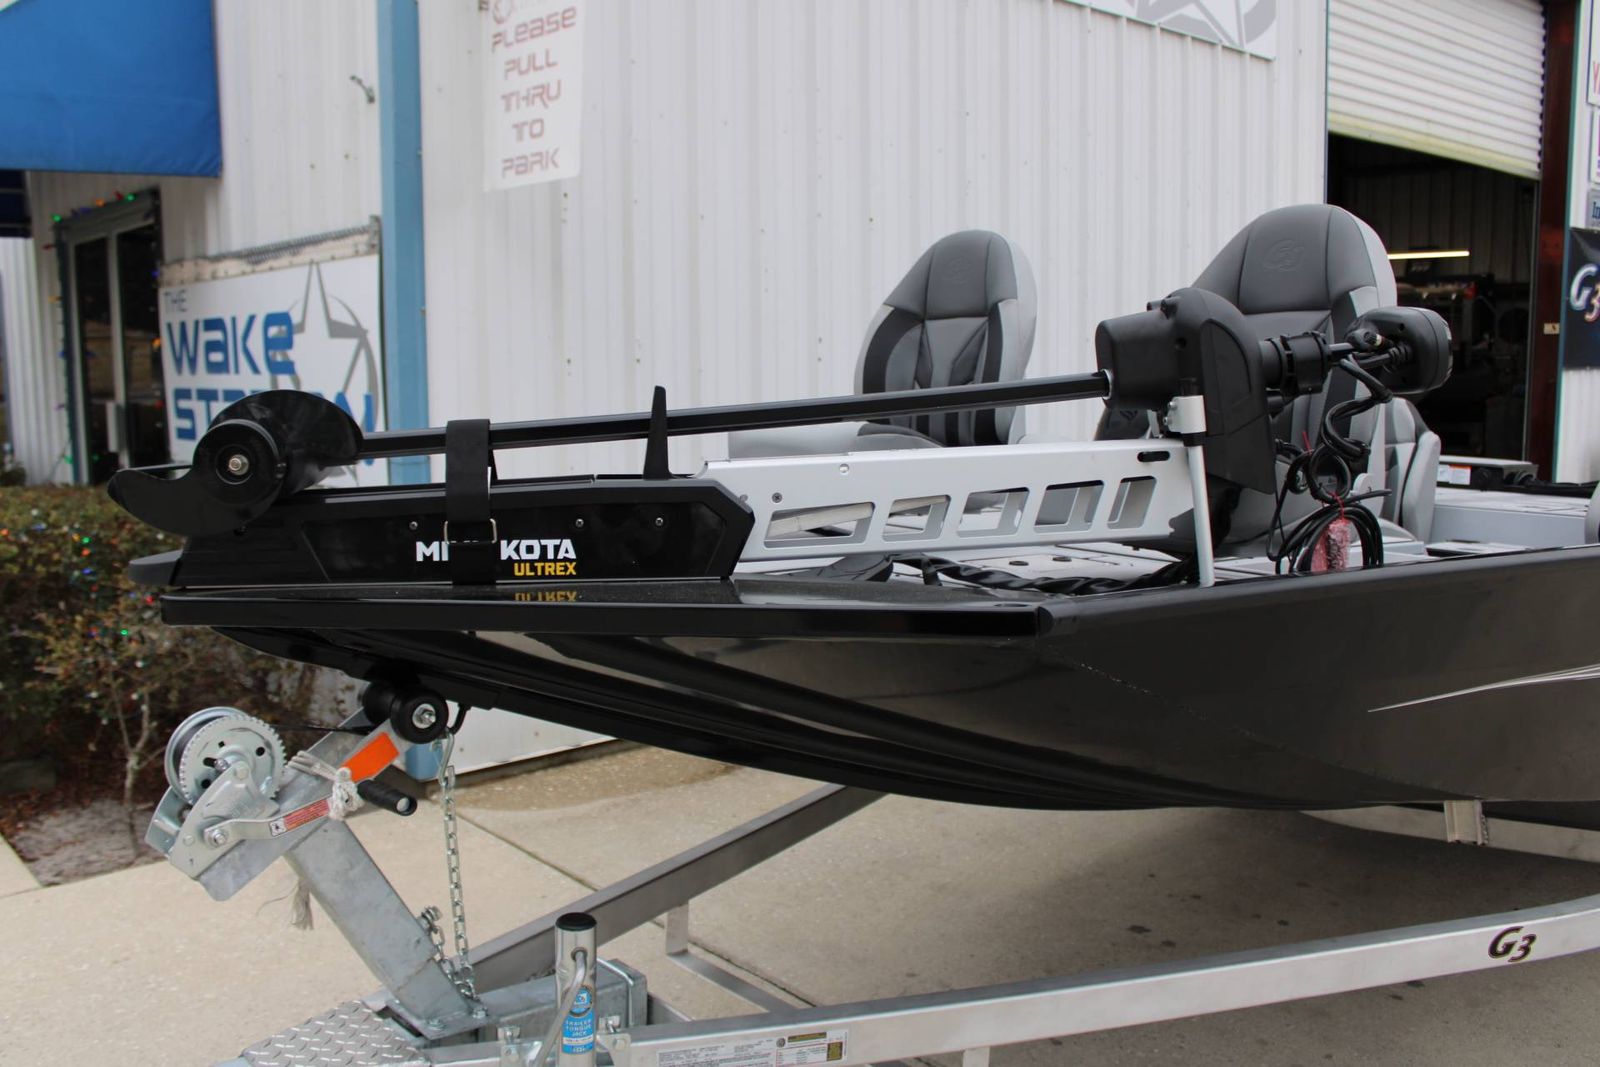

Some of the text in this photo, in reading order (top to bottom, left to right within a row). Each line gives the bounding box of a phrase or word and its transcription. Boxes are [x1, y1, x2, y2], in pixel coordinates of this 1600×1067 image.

[503, 48, 559, 80] PULL
[500, 79, 562, 112] THRU
[511, 118, 544, 141] TO
[164, 289, 187, 312] THE
[500, 539, 577, 560] KOTA
[514, 562, 577, 576] ULTREX
[1488, 925, 1537, 963] G3
